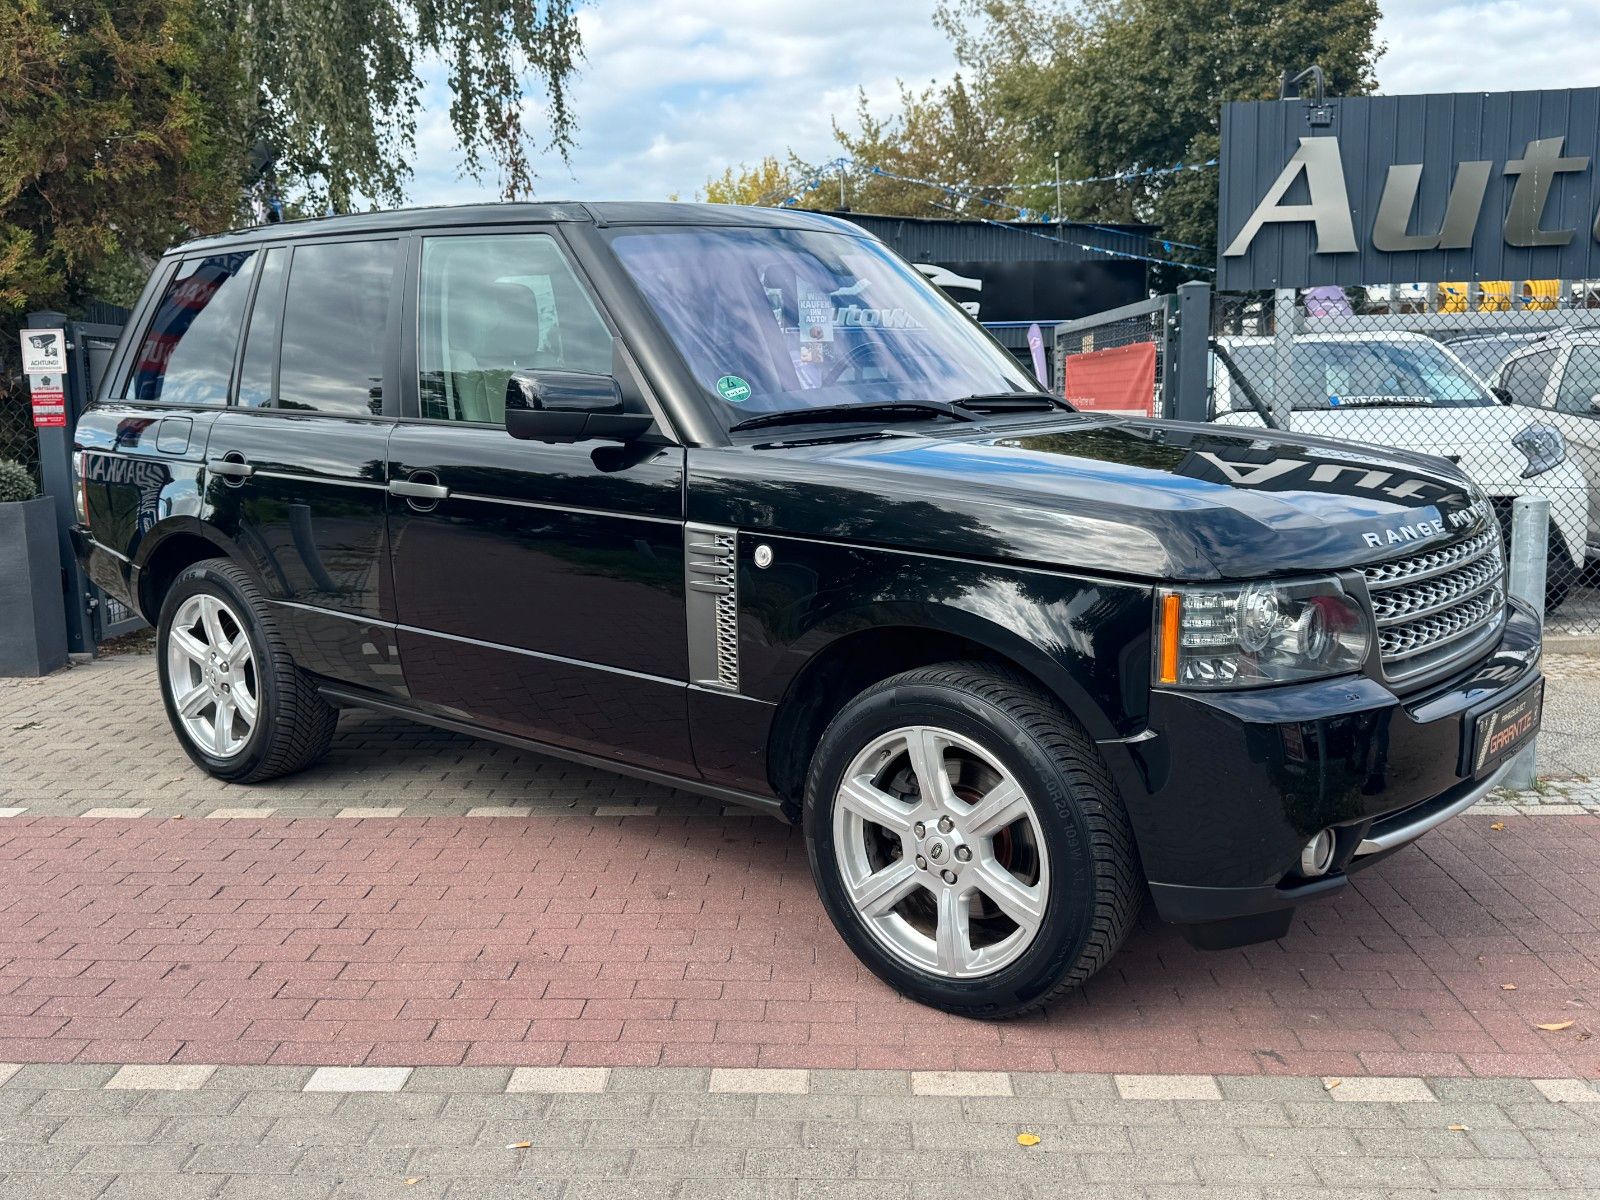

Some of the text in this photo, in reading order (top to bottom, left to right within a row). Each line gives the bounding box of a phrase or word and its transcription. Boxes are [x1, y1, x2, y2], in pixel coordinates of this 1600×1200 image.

[1223, 136, 1600, 257] Aut
[1362, 501, 1489, 548] RANGE ROVER
[1490, 710, 1533, 754] GARANTIE
